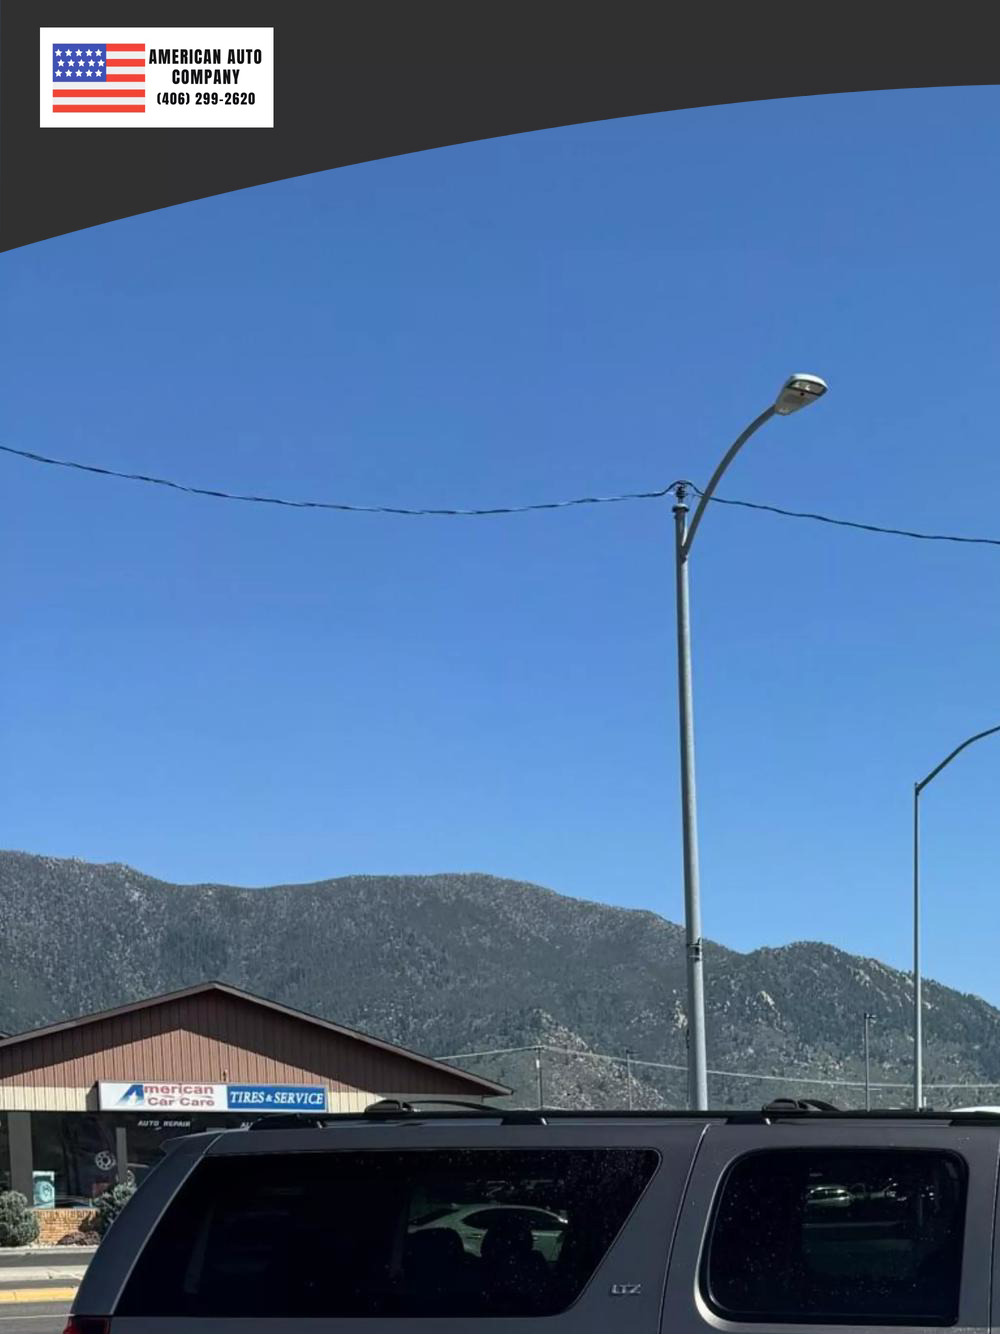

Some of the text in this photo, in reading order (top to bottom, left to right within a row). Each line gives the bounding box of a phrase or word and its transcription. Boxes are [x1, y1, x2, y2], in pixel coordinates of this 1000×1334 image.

[115, 1084, 214, 1106] American
[230, 1090, 265, 1104] TIRES
[274, 1091, 324, 1105] SERVICE
[147, 1097, 215, 1107] Car Care
[611, 1284, 641, 1294] LTZ
